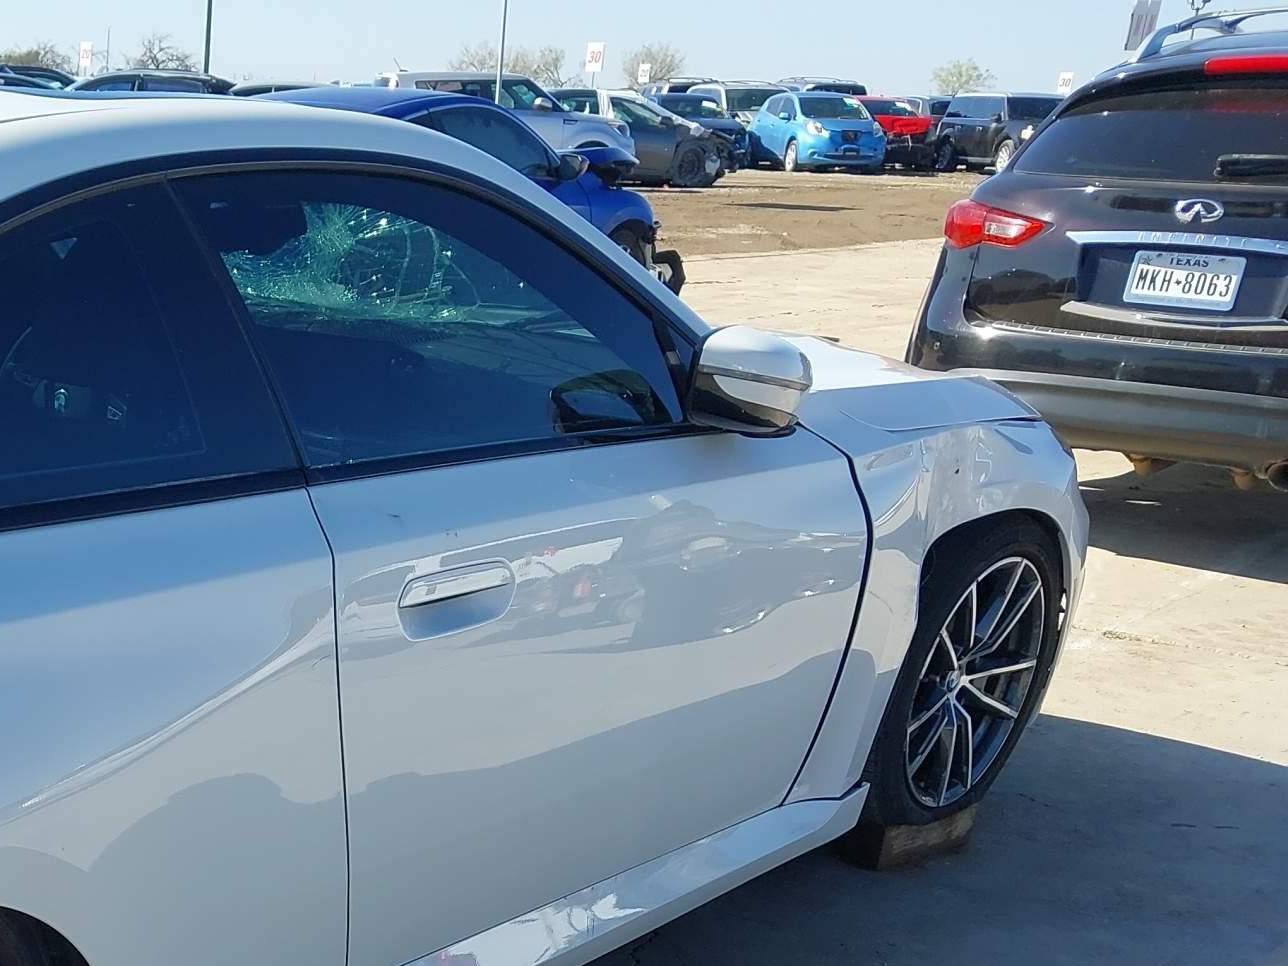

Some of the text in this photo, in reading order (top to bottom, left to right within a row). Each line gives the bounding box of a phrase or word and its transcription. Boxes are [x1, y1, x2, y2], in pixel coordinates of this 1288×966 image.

[588, 50, 602, 64] 30
[1059, 78, 1072, 88] 30
[1169, 257, 1209, 268] TEXAS
